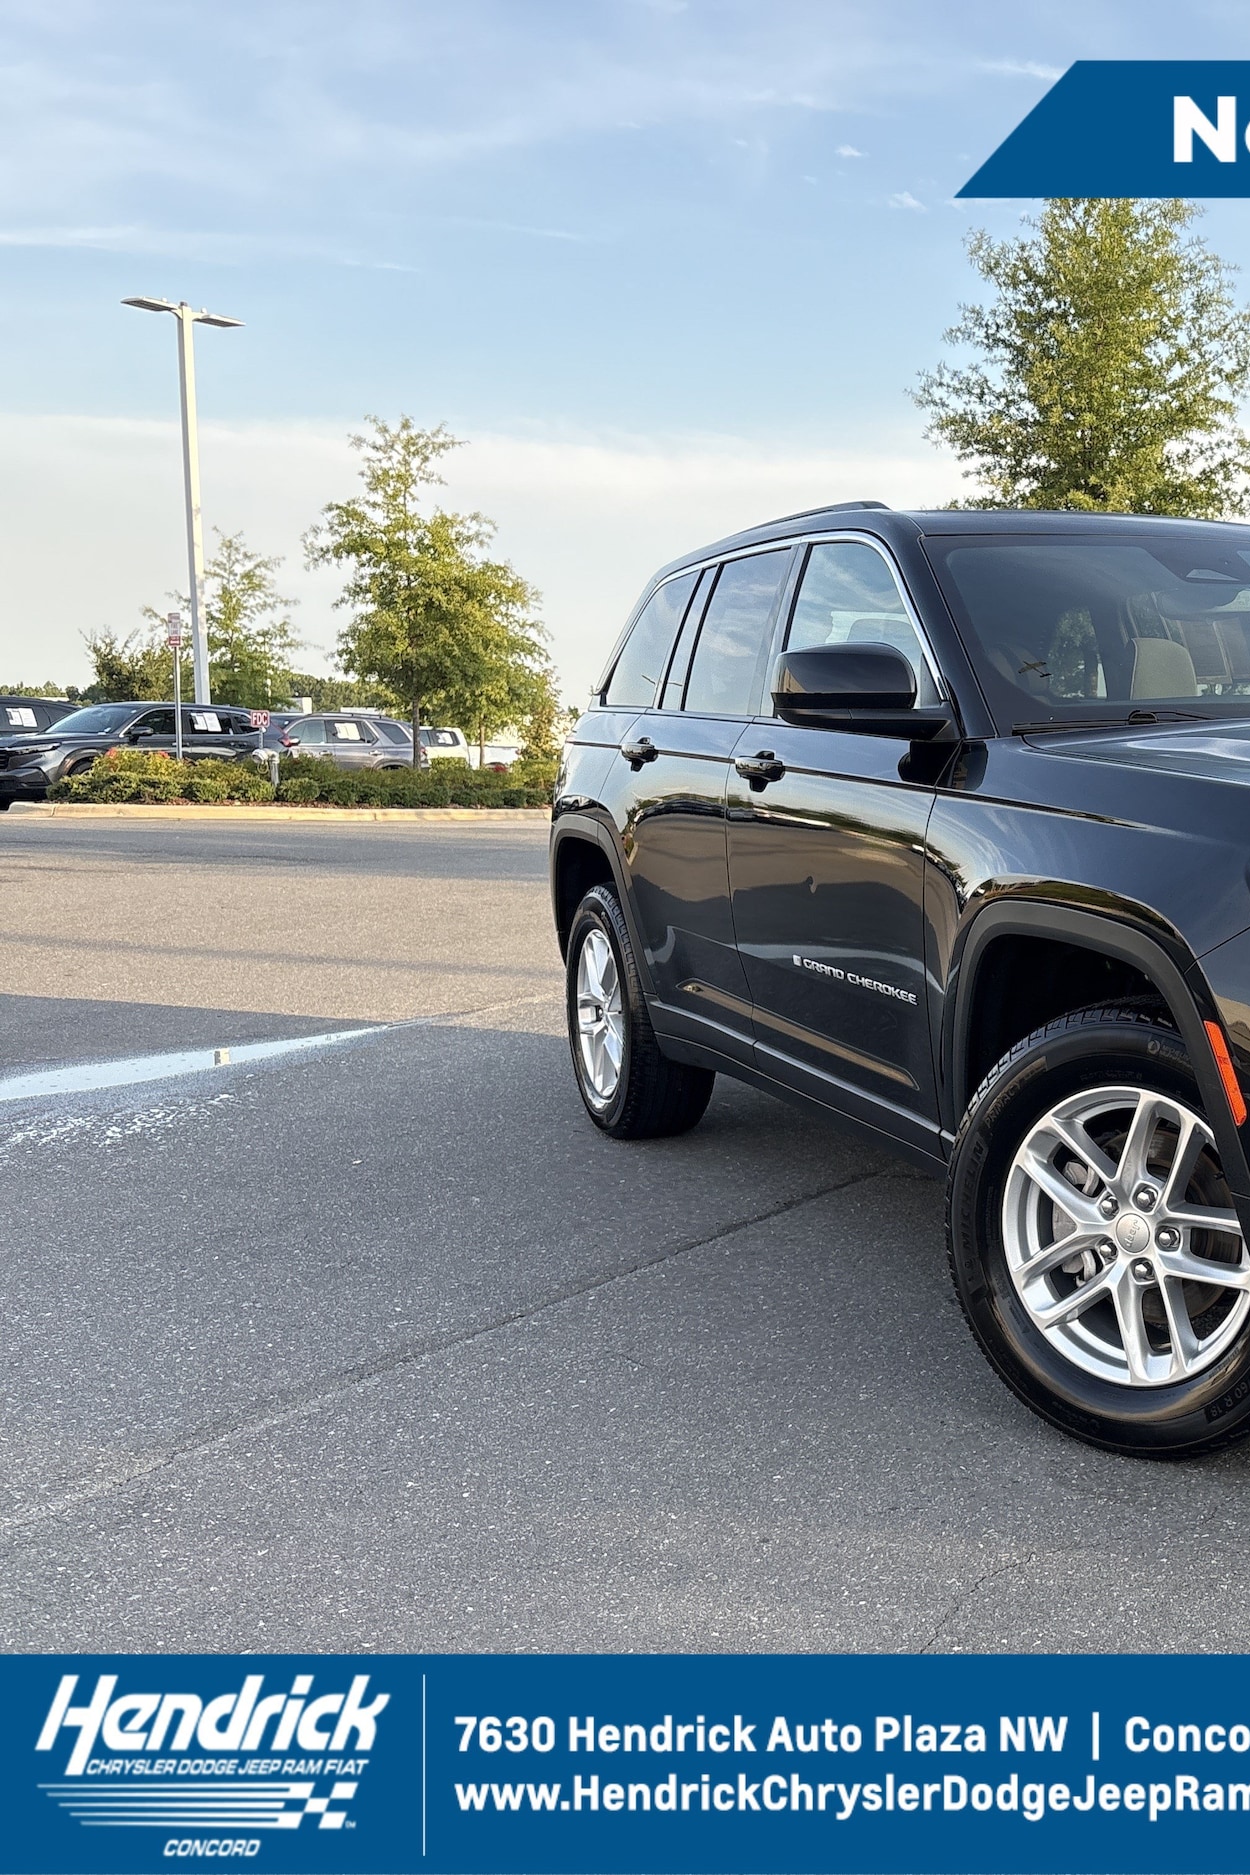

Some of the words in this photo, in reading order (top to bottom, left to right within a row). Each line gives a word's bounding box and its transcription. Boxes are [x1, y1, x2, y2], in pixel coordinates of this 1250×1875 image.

[252, 711, 268, 726] FDC
[803, 958, 844, 980] GRAND
[847, 972, 917, 1006] CHEROKEE
[959, 1139, 985, 1251] MICHELIN
